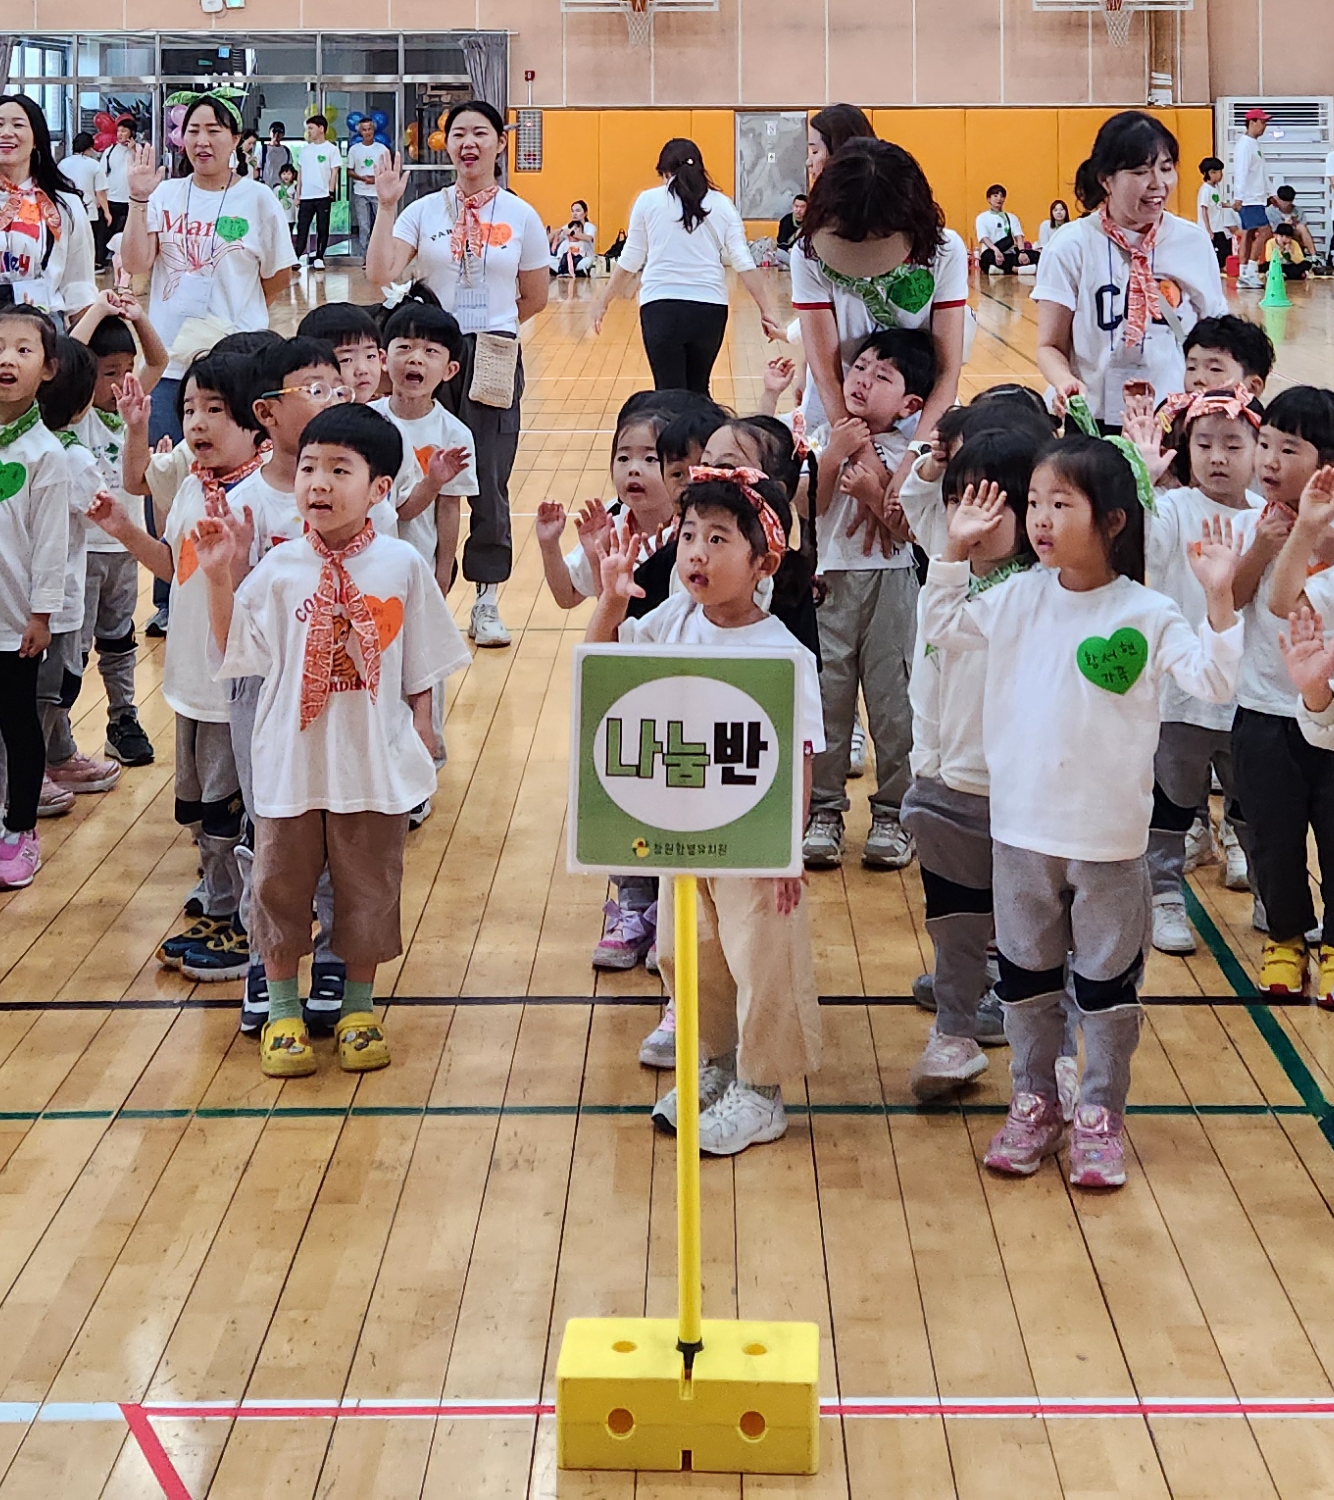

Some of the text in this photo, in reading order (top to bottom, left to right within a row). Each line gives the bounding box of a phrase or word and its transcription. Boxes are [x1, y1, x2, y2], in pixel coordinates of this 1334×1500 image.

[160, 209, 213, 238] Mar
[1101, 665, 1130, 684] 가족
[329, 679, 367, 693] RDEN
[605, 717, 769, 788] 나눔반
[653, 841, 728, 857] 창원한별유치원
